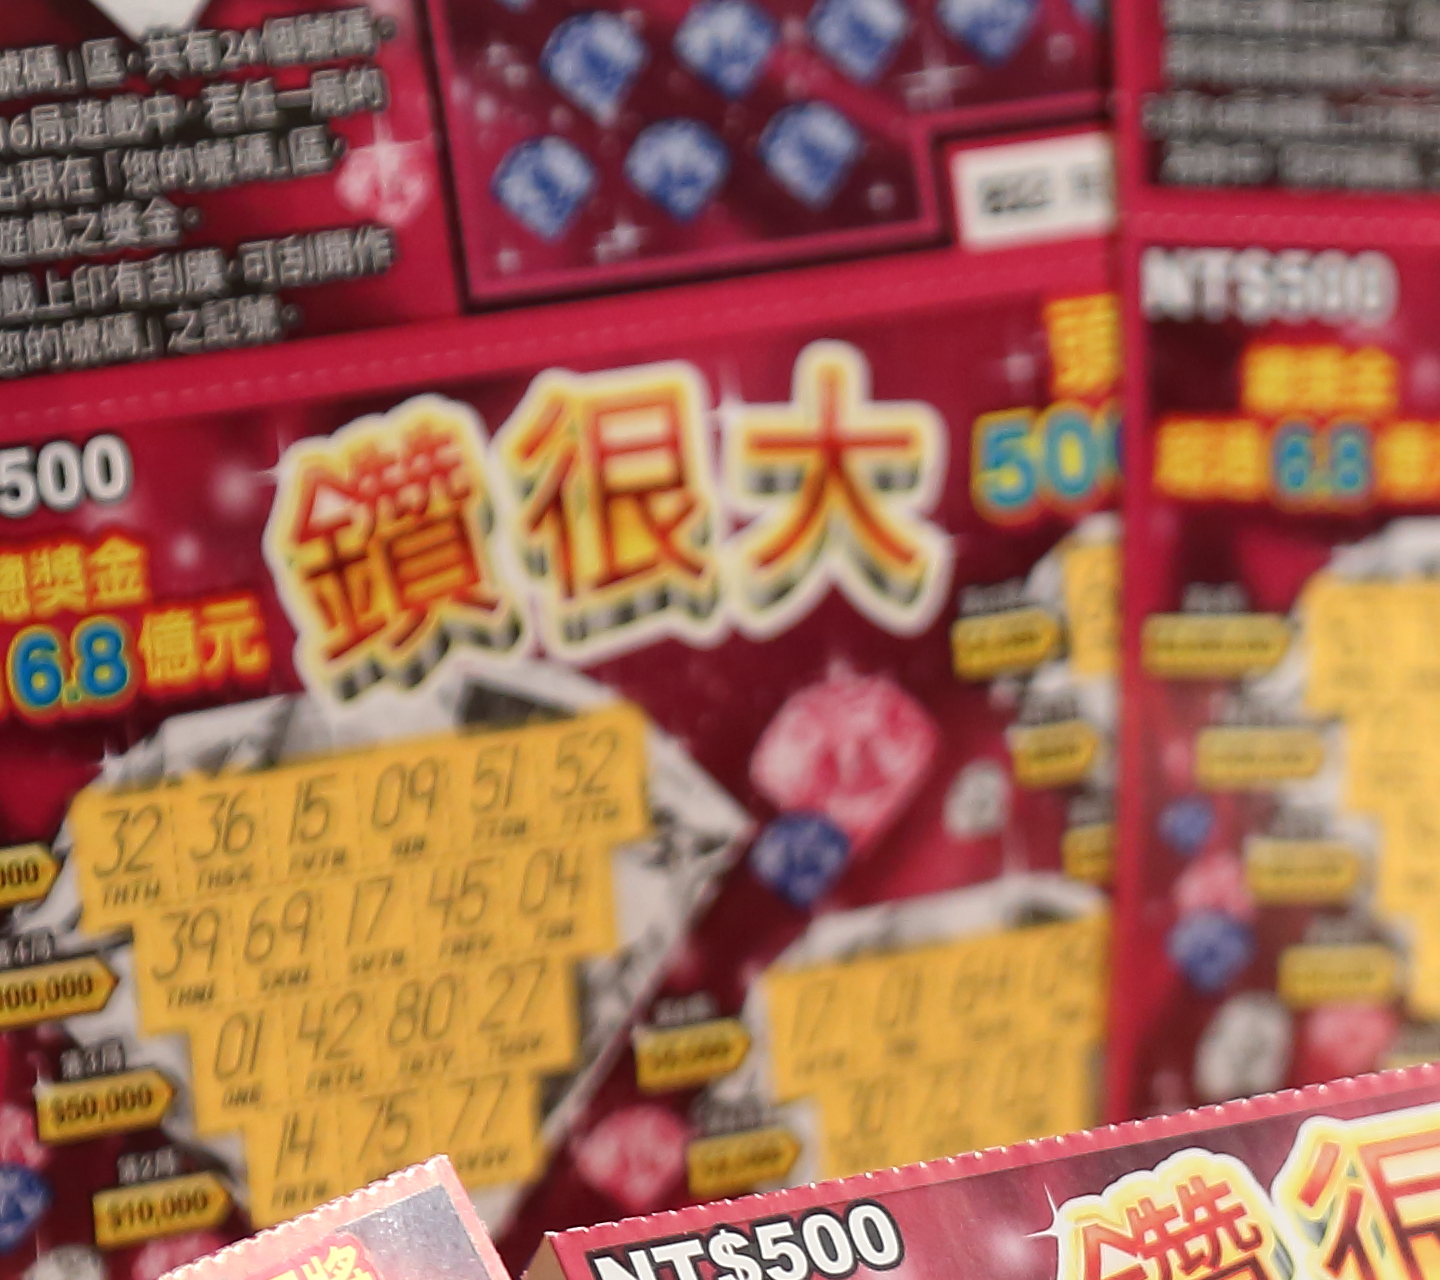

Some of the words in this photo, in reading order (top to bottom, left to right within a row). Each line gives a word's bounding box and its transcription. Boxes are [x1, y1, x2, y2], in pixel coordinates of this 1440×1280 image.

[1142, 248, 1398, 325] NT$500
[278, 350, 938, 685] 鑽很大
[94, 805, 160, 882] 32
[191, 791, 255, 860] 36
